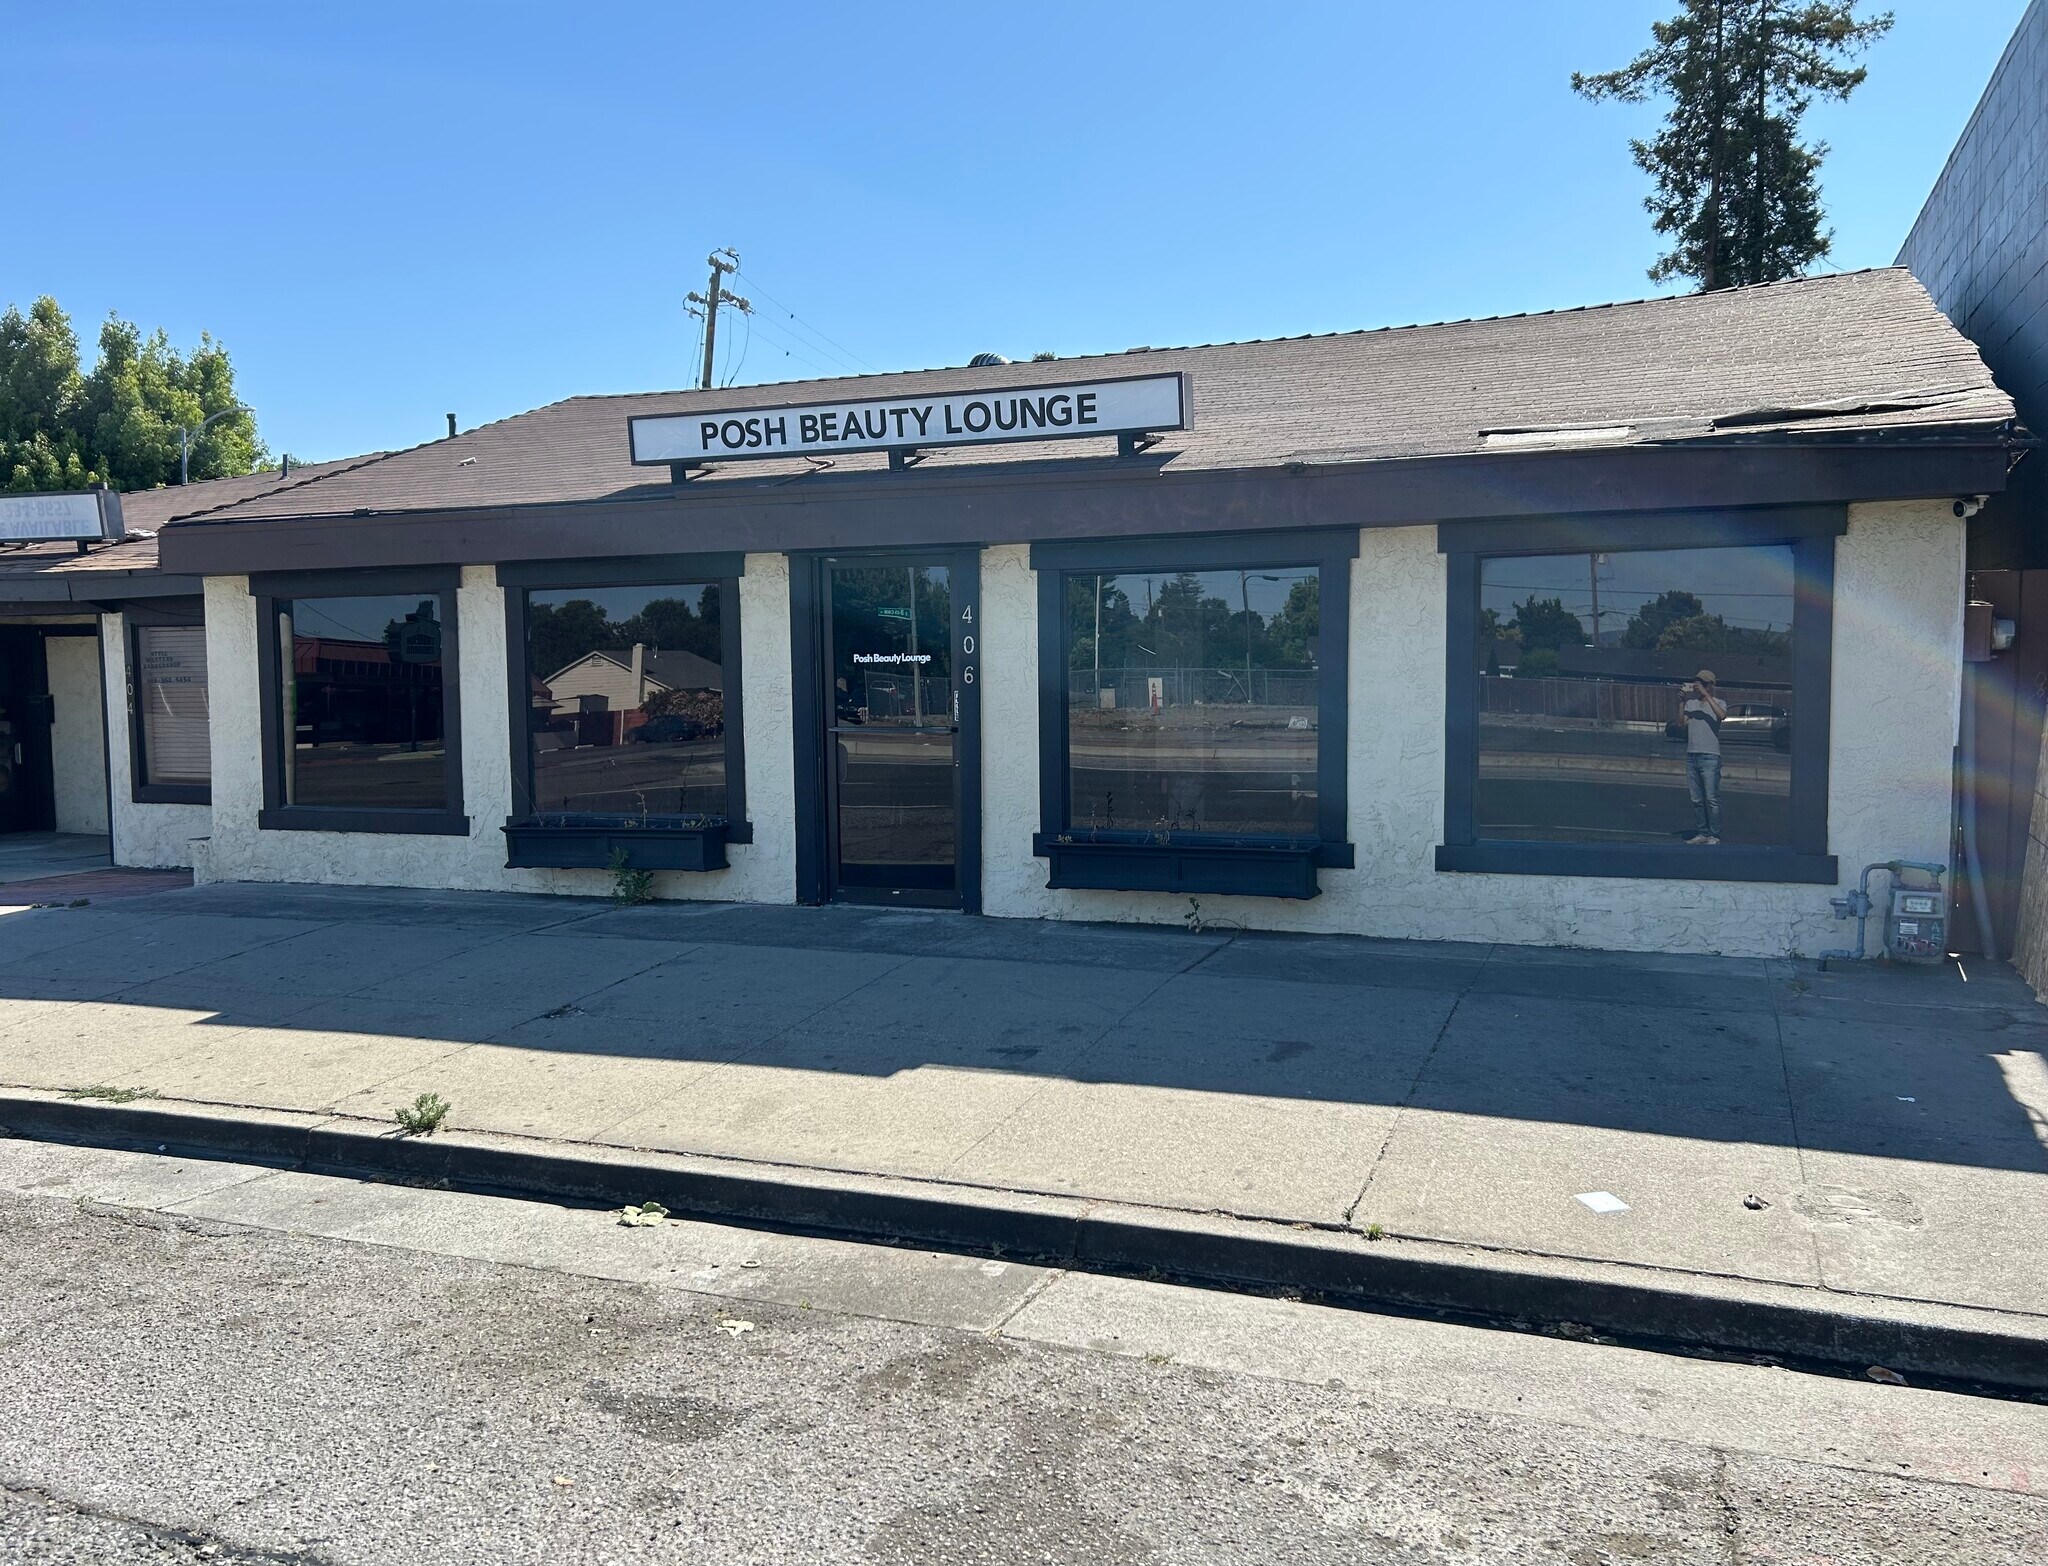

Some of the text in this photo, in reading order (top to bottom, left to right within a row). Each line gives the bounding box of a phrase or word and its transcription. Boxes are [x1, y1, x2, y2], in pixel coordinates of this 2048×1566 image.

[701, 393, 1098, 450] POSH BEAUTY LOUNGE
[853, 652, 931, 664] Posh Beauty Lounge
[962, 604, 975, 684] 406
